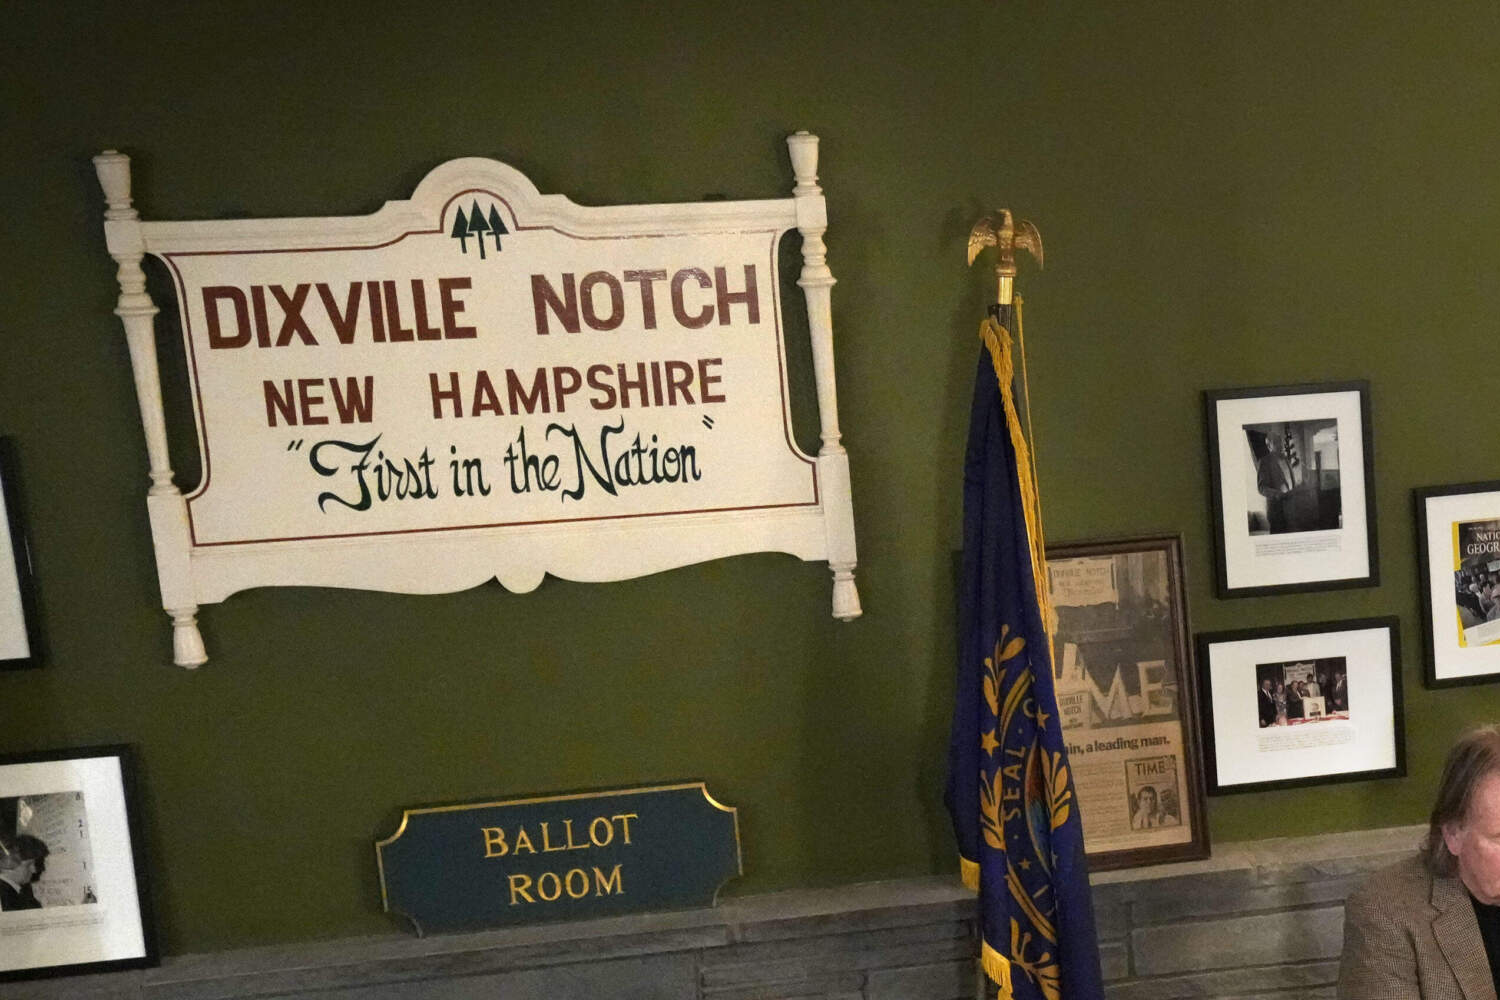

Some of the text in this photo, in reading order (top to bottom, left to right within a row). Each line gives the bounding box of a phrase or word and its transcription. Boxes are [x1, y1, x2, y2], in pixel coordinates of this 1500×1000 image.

[202, 264, 760, 349] DIXVILLE NOTCH
[263, 358, 726, 427] NEW HAMPSHIRE
[449, 445, 491, 497] in
[503, 425, 561, 494] the
[1086, 743, 1093, 753] a
[1094, 737, 1139, 752] leading
[1140, 736, 1171, 747] man.
[1134, 761, 1166, 776] TIME
[1003, 746, 1026, 821] SEAL
[481, 813, 638, 858] BALLOT
[507, 864, 625, 905] ROOM
